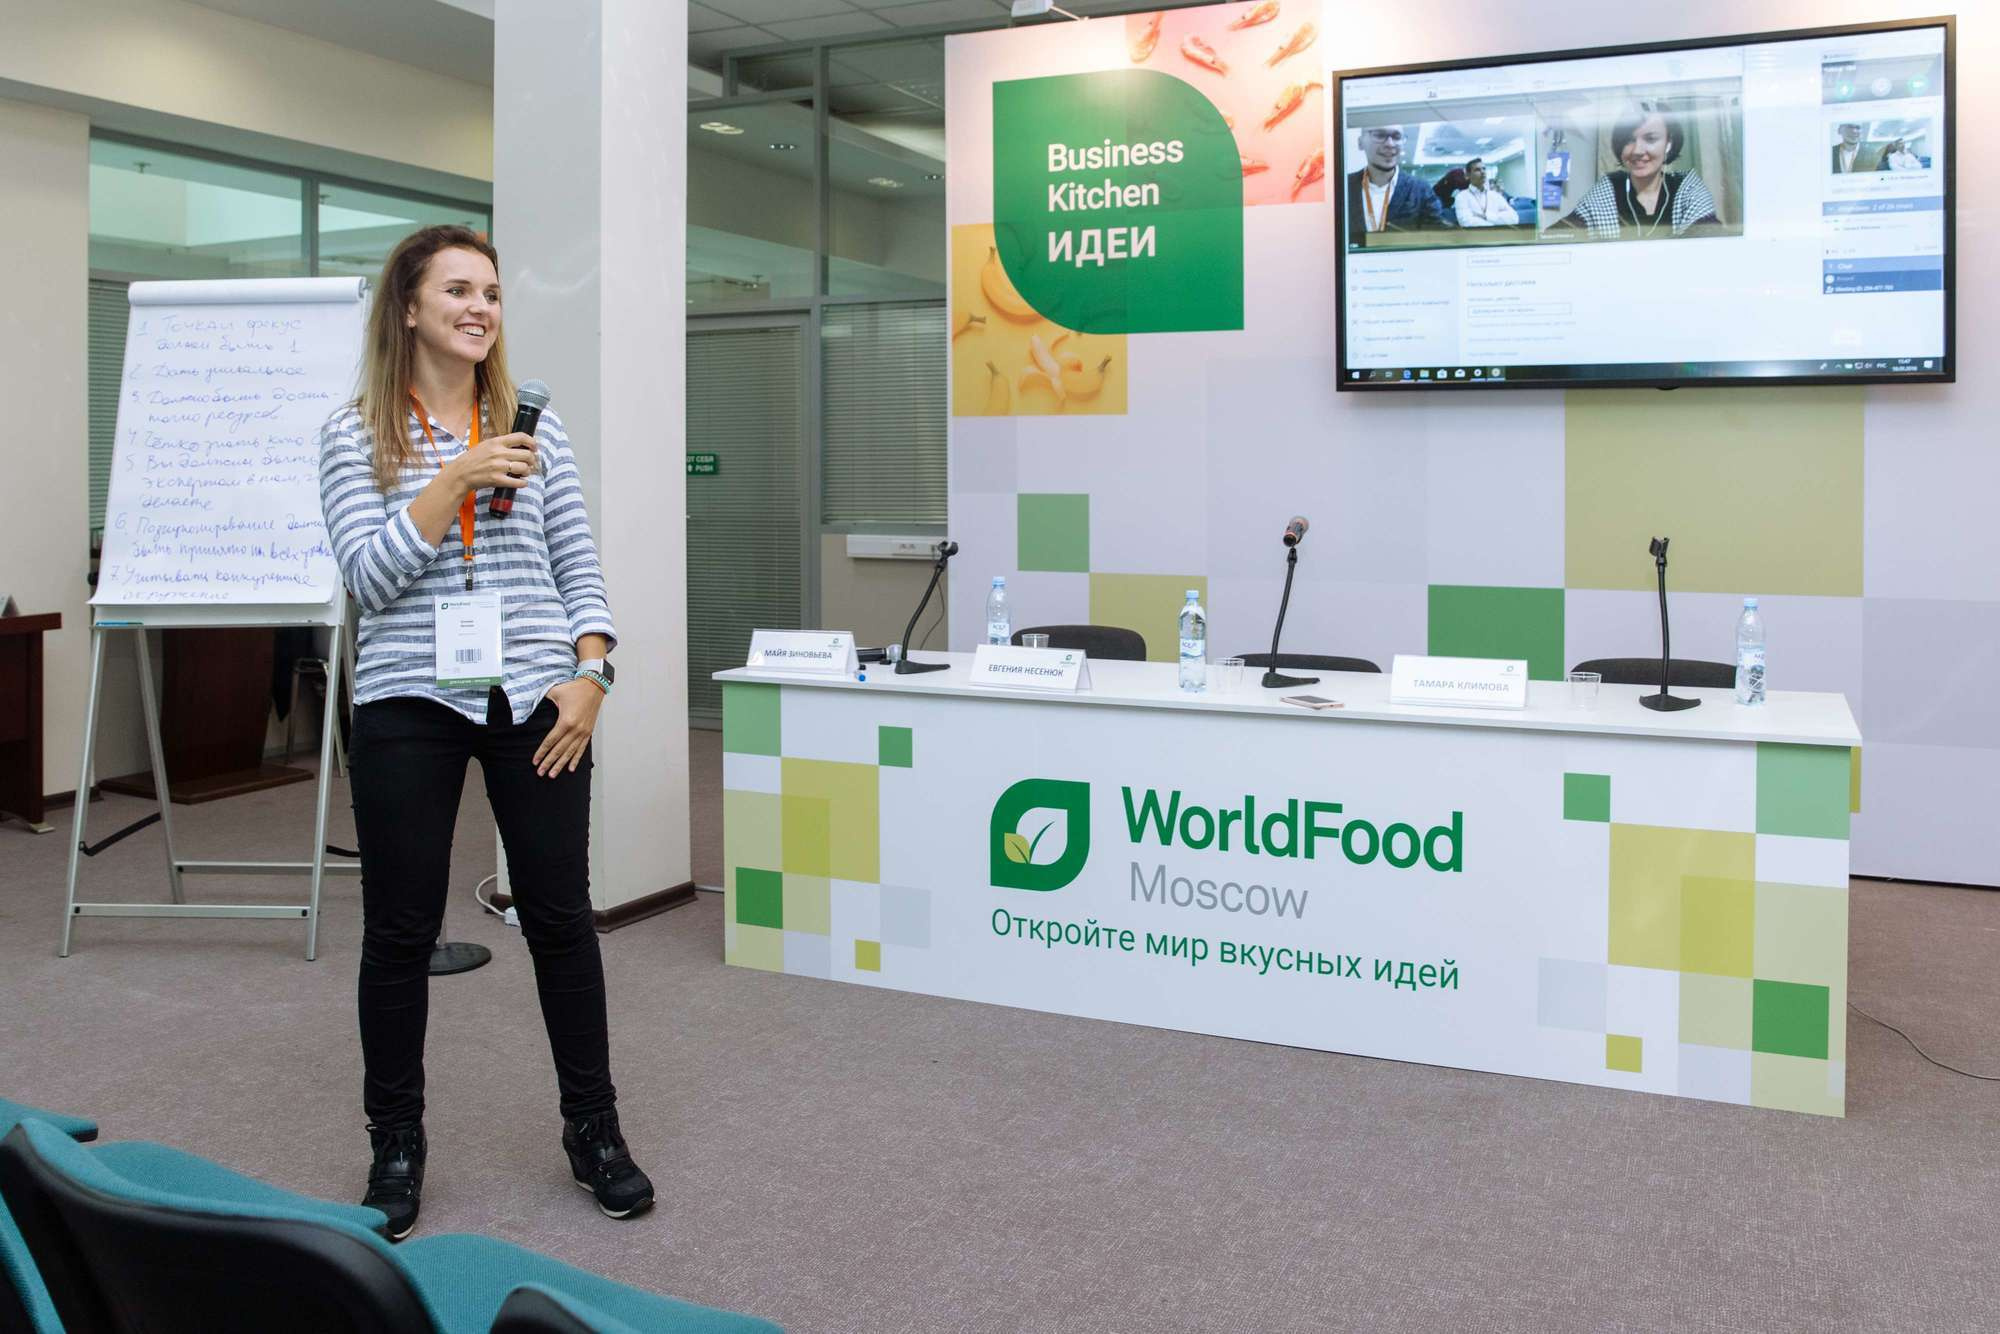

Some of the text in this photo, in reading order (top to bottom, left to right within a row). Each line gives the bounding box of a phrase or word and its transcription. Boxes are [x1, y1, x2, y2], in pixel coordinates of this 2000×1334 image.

[1048, 138, 1184, 173] Business
[1048, 178, 1160, 212] Kitchen
[1048, 225, 1156, 268] ИДЕИ
[764, 648, 787, 657] МАЙЯ
[988, 664, 1064, 677] ЕВГЕНИЯ НЕСЕНЮК
[1413, 679, 1510, 692] ТАМАРА КЛИМОВА
[1121, 785, 1463, 874] WorldFood
[1130, 861, 1309, 919] Moscow
[991, 908, 1459, 993] Откройте мир вкусных идей
